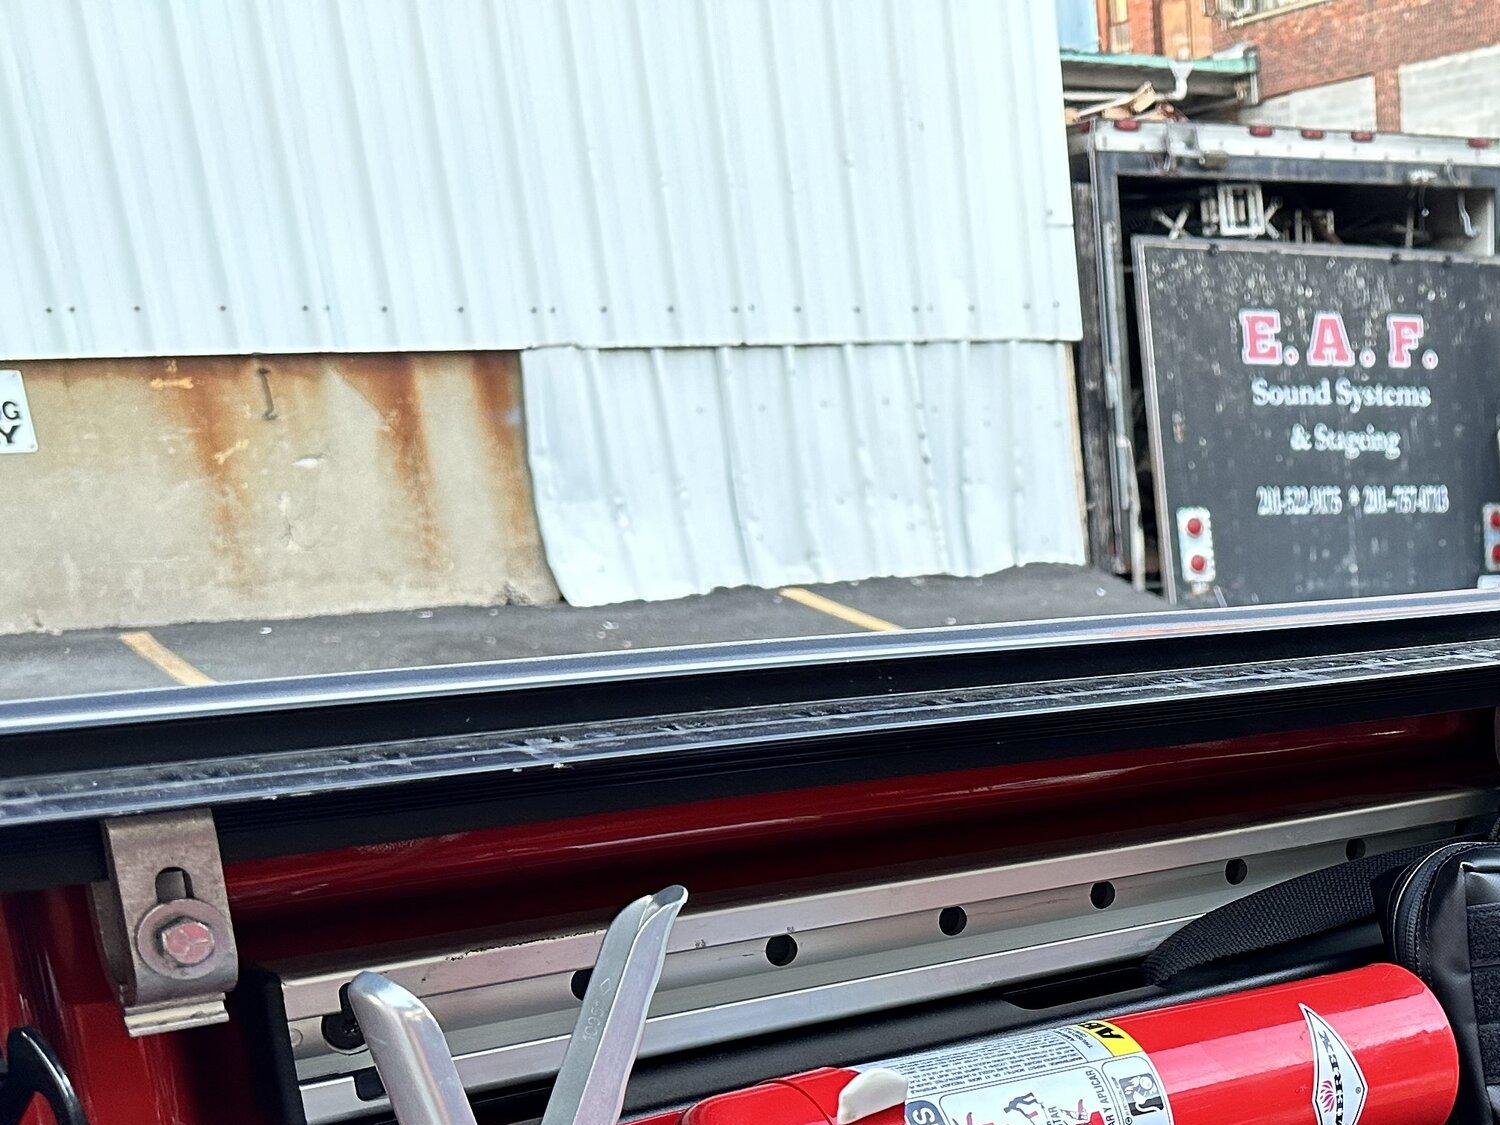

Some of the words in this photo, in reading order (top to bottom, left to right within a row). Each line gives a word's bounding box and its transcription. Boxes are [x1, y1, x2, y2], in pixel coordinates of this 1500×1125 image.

[1239, 308, 1439, 370] E.A.F.
[1252, 376, 1333, 406] Sound
[1335, 376, 1432, 414] Systems
[1290, 423, 1312, 451] &
[1313, 422, 1401, 460] Staging
[1085, 1070, 1109, 1104] APLICAR
